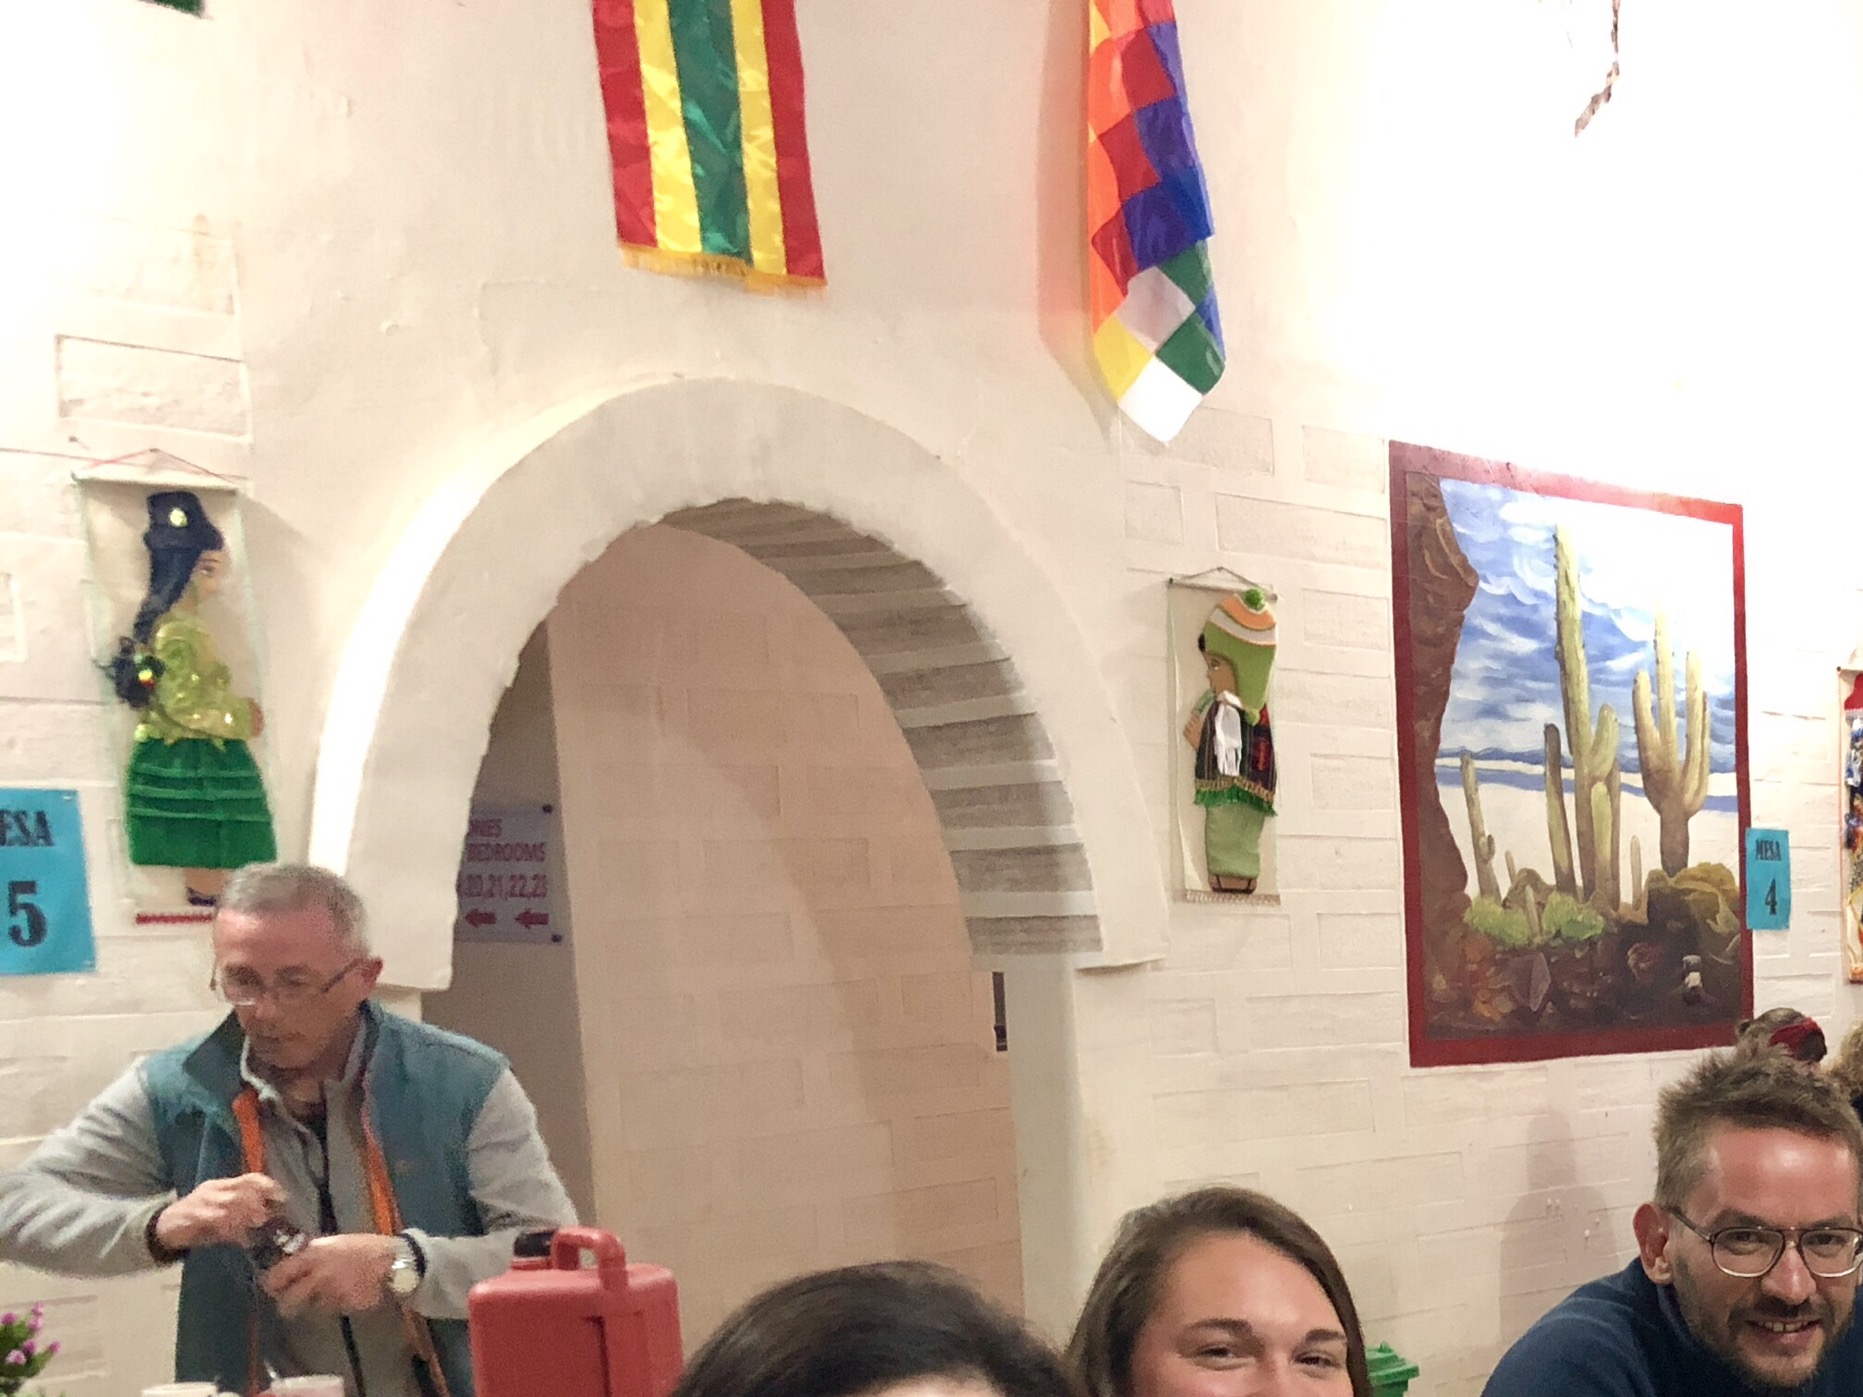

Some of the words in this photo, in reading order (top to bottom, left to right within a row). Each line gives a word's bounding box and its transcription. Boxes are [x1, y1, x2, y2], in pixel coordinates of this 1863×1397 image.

[0, 810, 55, 847] ESA
[1755, 839, 1781, 861] MESA
[8, 880, 48, 947] 5
[1765, 879, 1778, 915] 4
